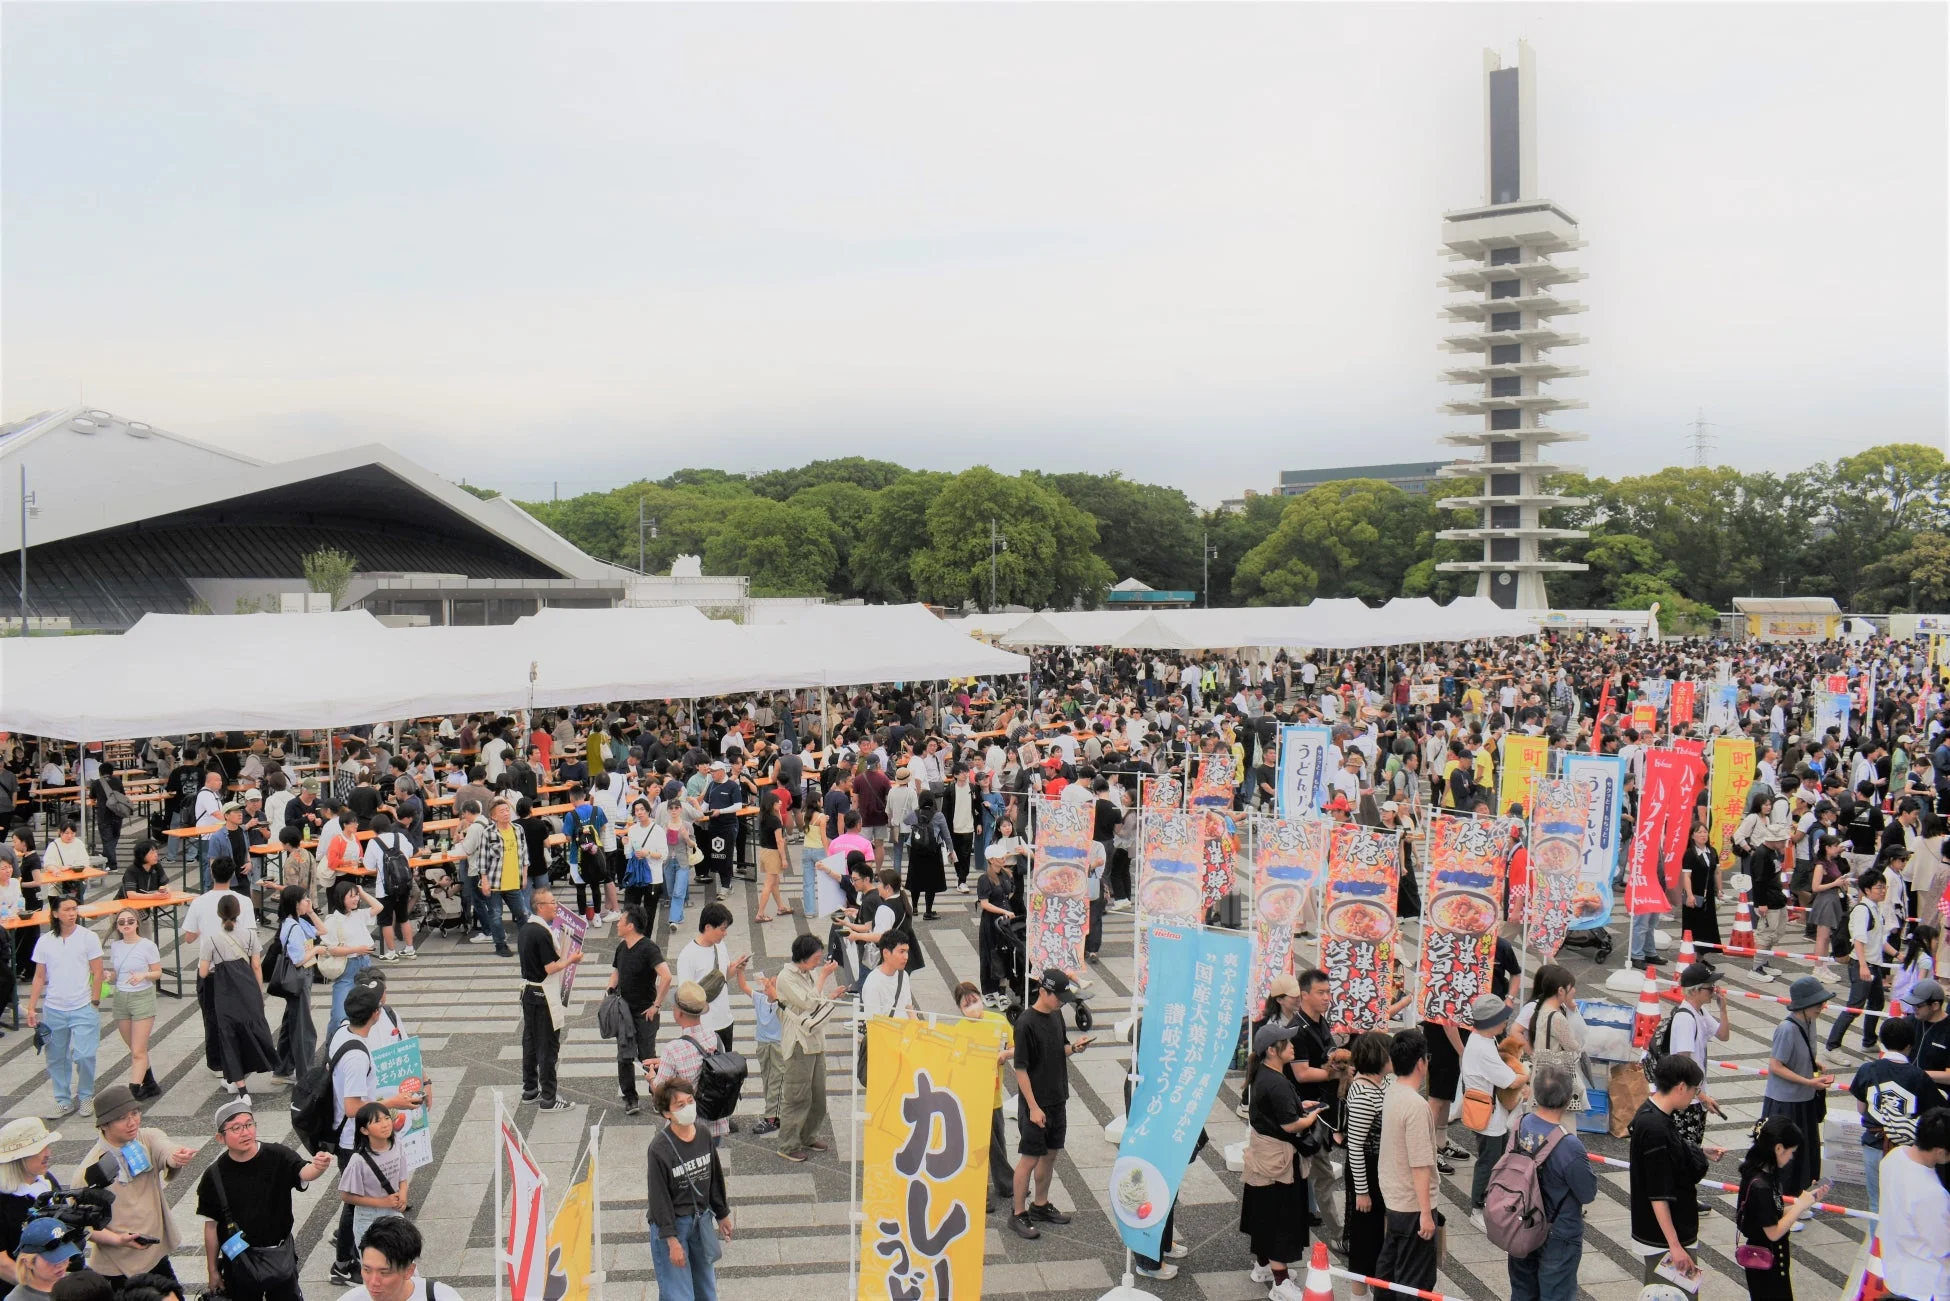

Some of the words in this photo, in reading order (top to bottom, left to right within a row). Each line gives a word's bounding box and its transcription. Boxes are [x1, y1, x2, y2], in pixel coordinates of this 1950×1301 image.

[1723, 751, 1752, 819] 町中華
[1345, 834, 1379, 866] 俺
[1453, 822, 1488, 857] 俺
[1629, 777, 1665, 887] ハウス食品
[893, 1068, 970, 1301] カレー
